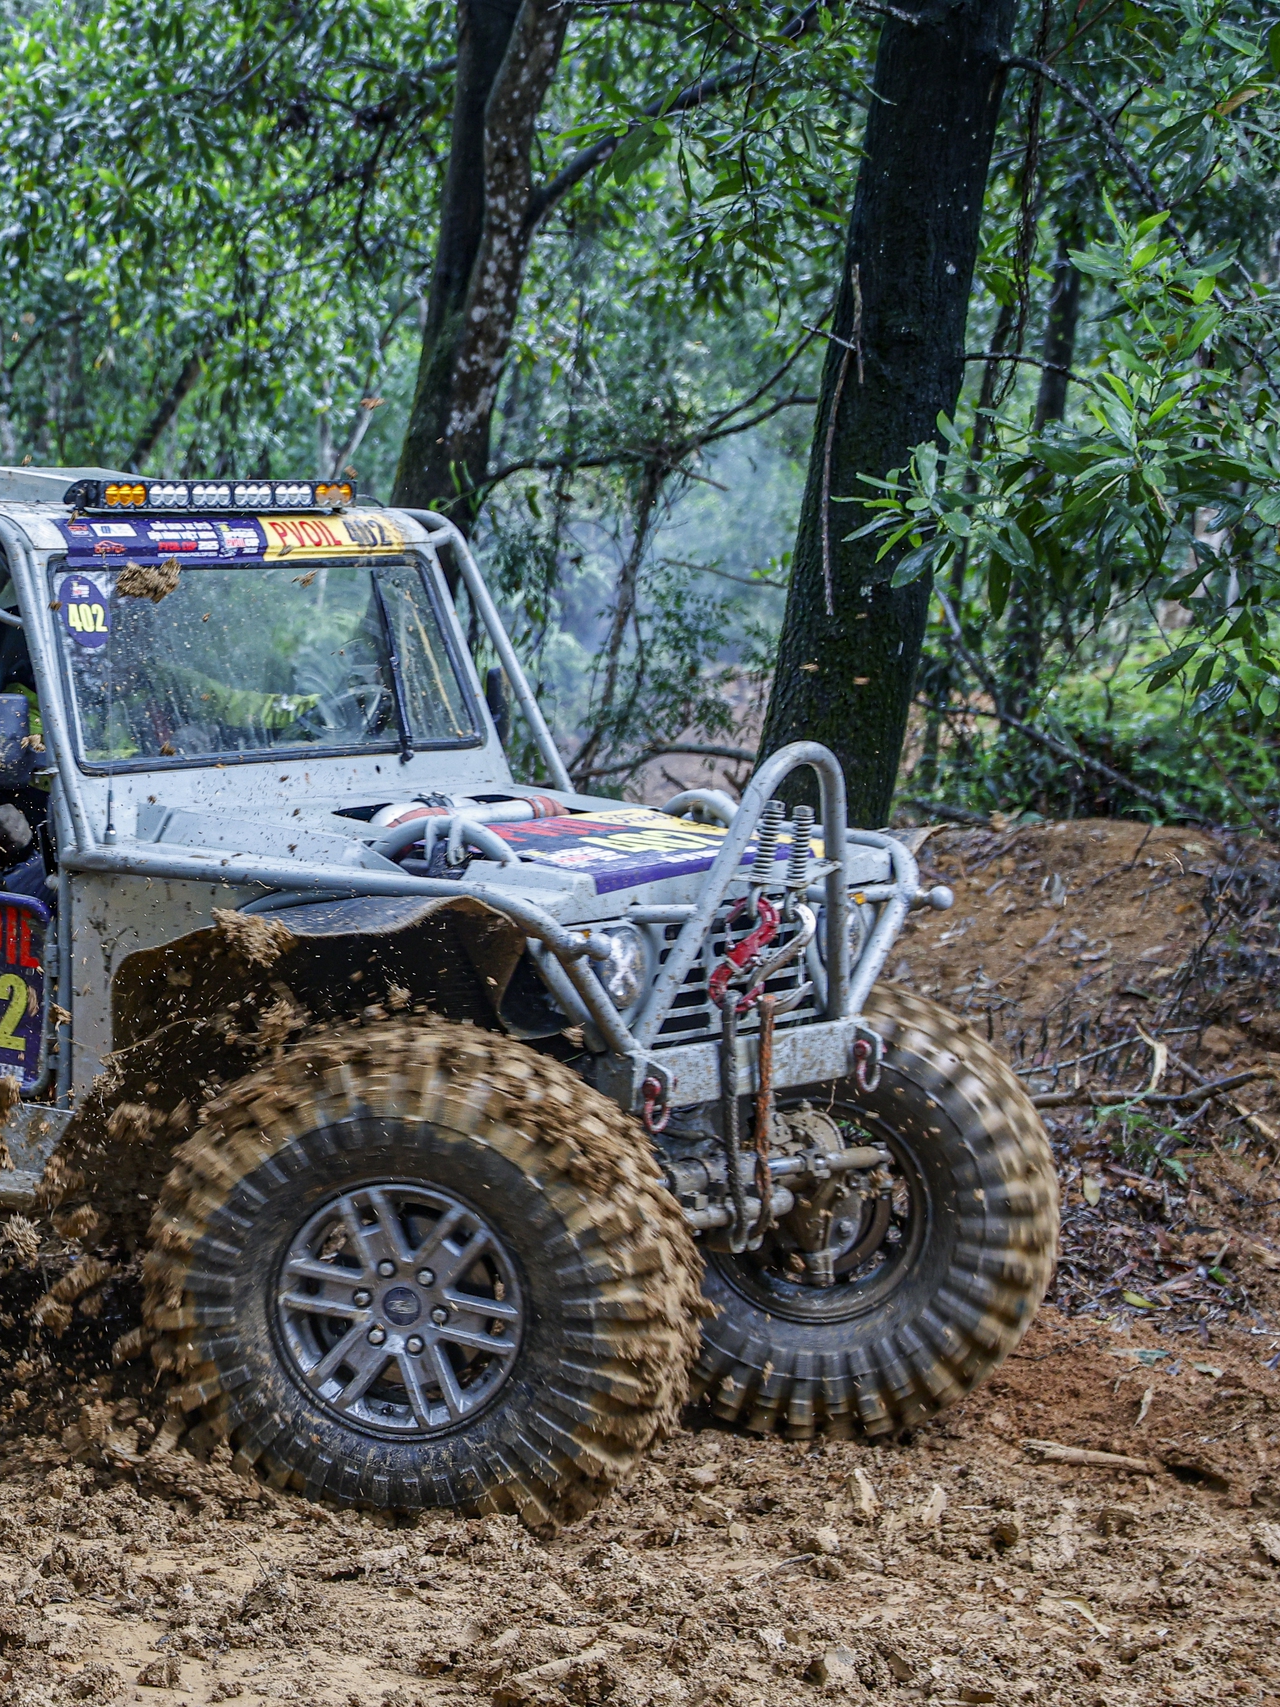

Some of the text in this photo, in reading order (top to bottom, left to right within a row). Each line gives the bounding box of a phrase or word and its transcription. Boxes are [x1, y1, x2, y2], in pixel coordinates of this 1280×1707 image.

[267, 520, 343, 547] PVOIL
[341, 519, 393, 547] 402
[67, 602, 109, 633] 402
